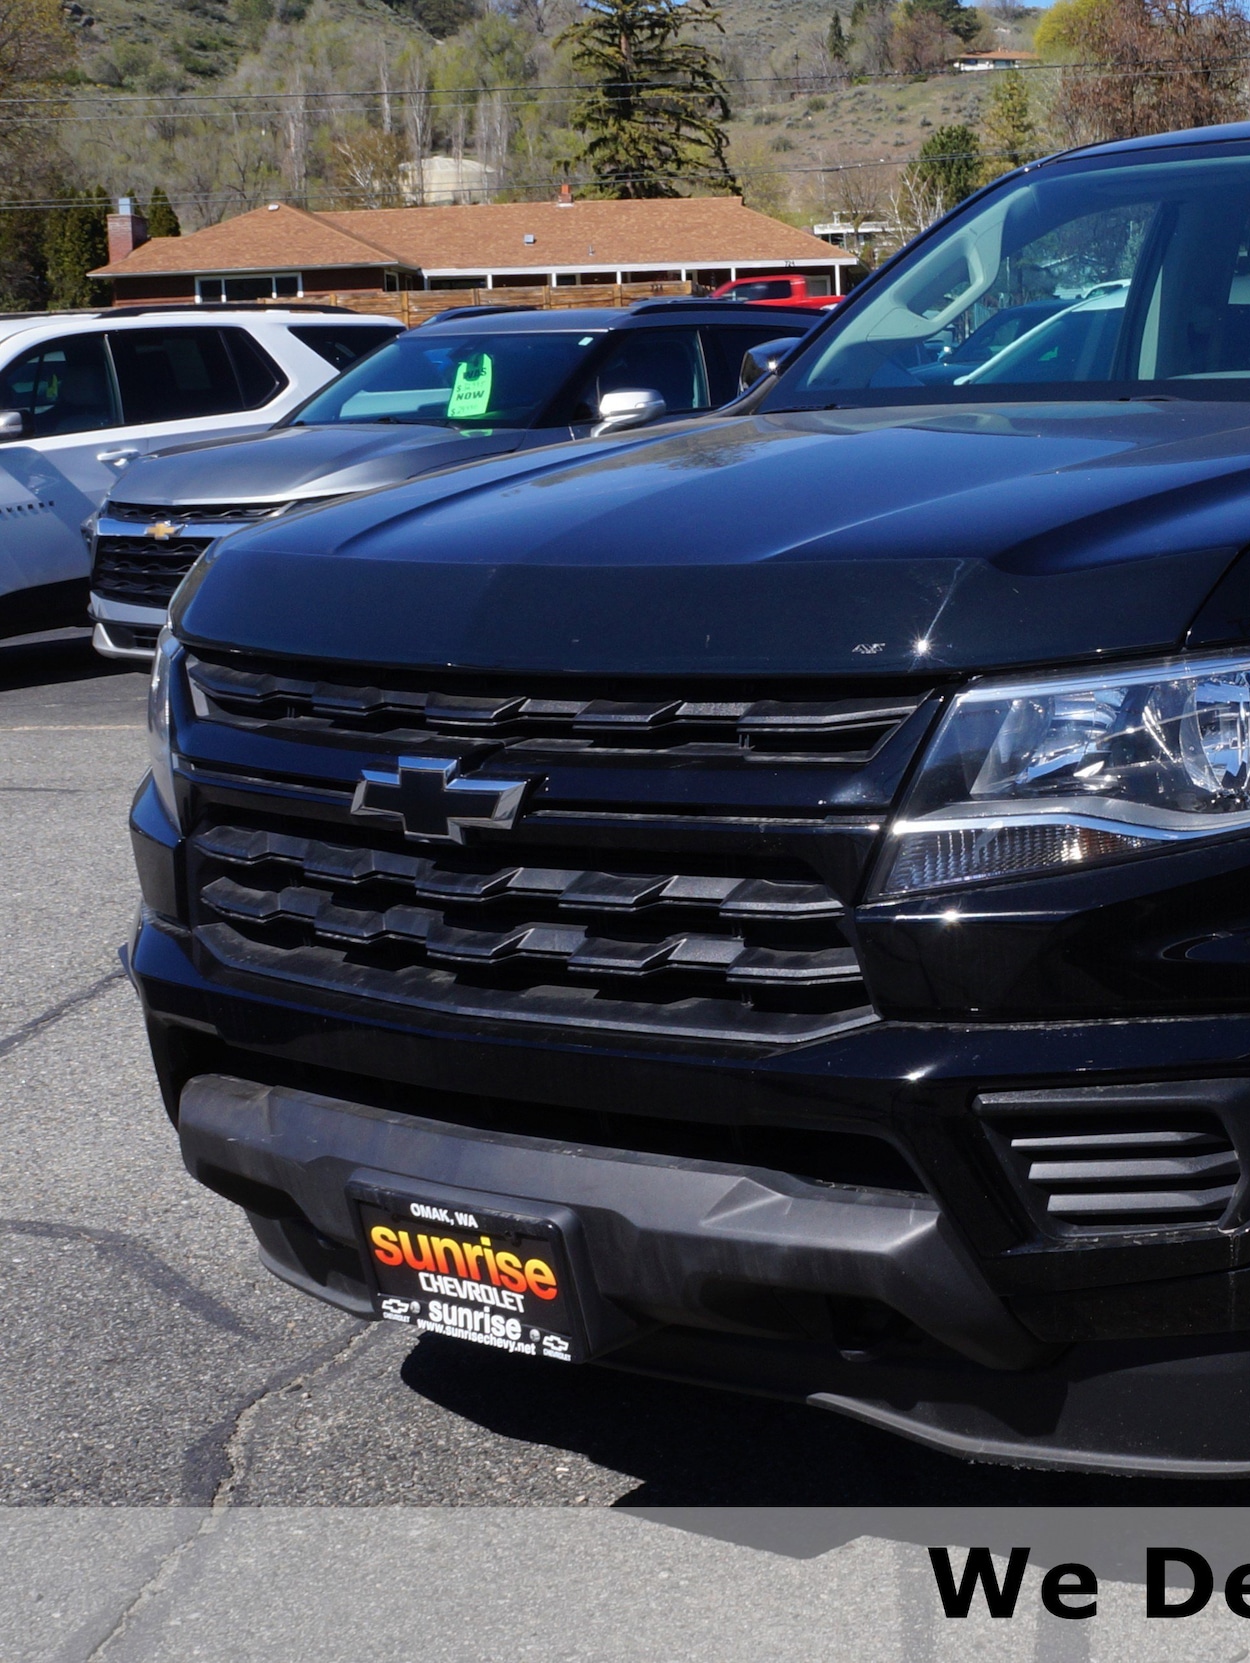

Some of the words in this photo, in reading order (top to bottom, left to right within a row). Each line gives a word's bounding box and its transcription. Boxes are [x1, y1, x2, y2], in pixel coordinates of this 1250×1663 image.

[456, 390, 485, 401] NOW
[410, 1202, 454, 1226] OMAK,
[454, 1211, 479, 1229] WA
[370, 1225, 558, 1301] sunrise
[418, 1271, 525, 1313] CHEVROLET
[417, 1318, 536, 1356] www.sunrisechevy.net
[428, 1300, 522, 1341] sunrise
